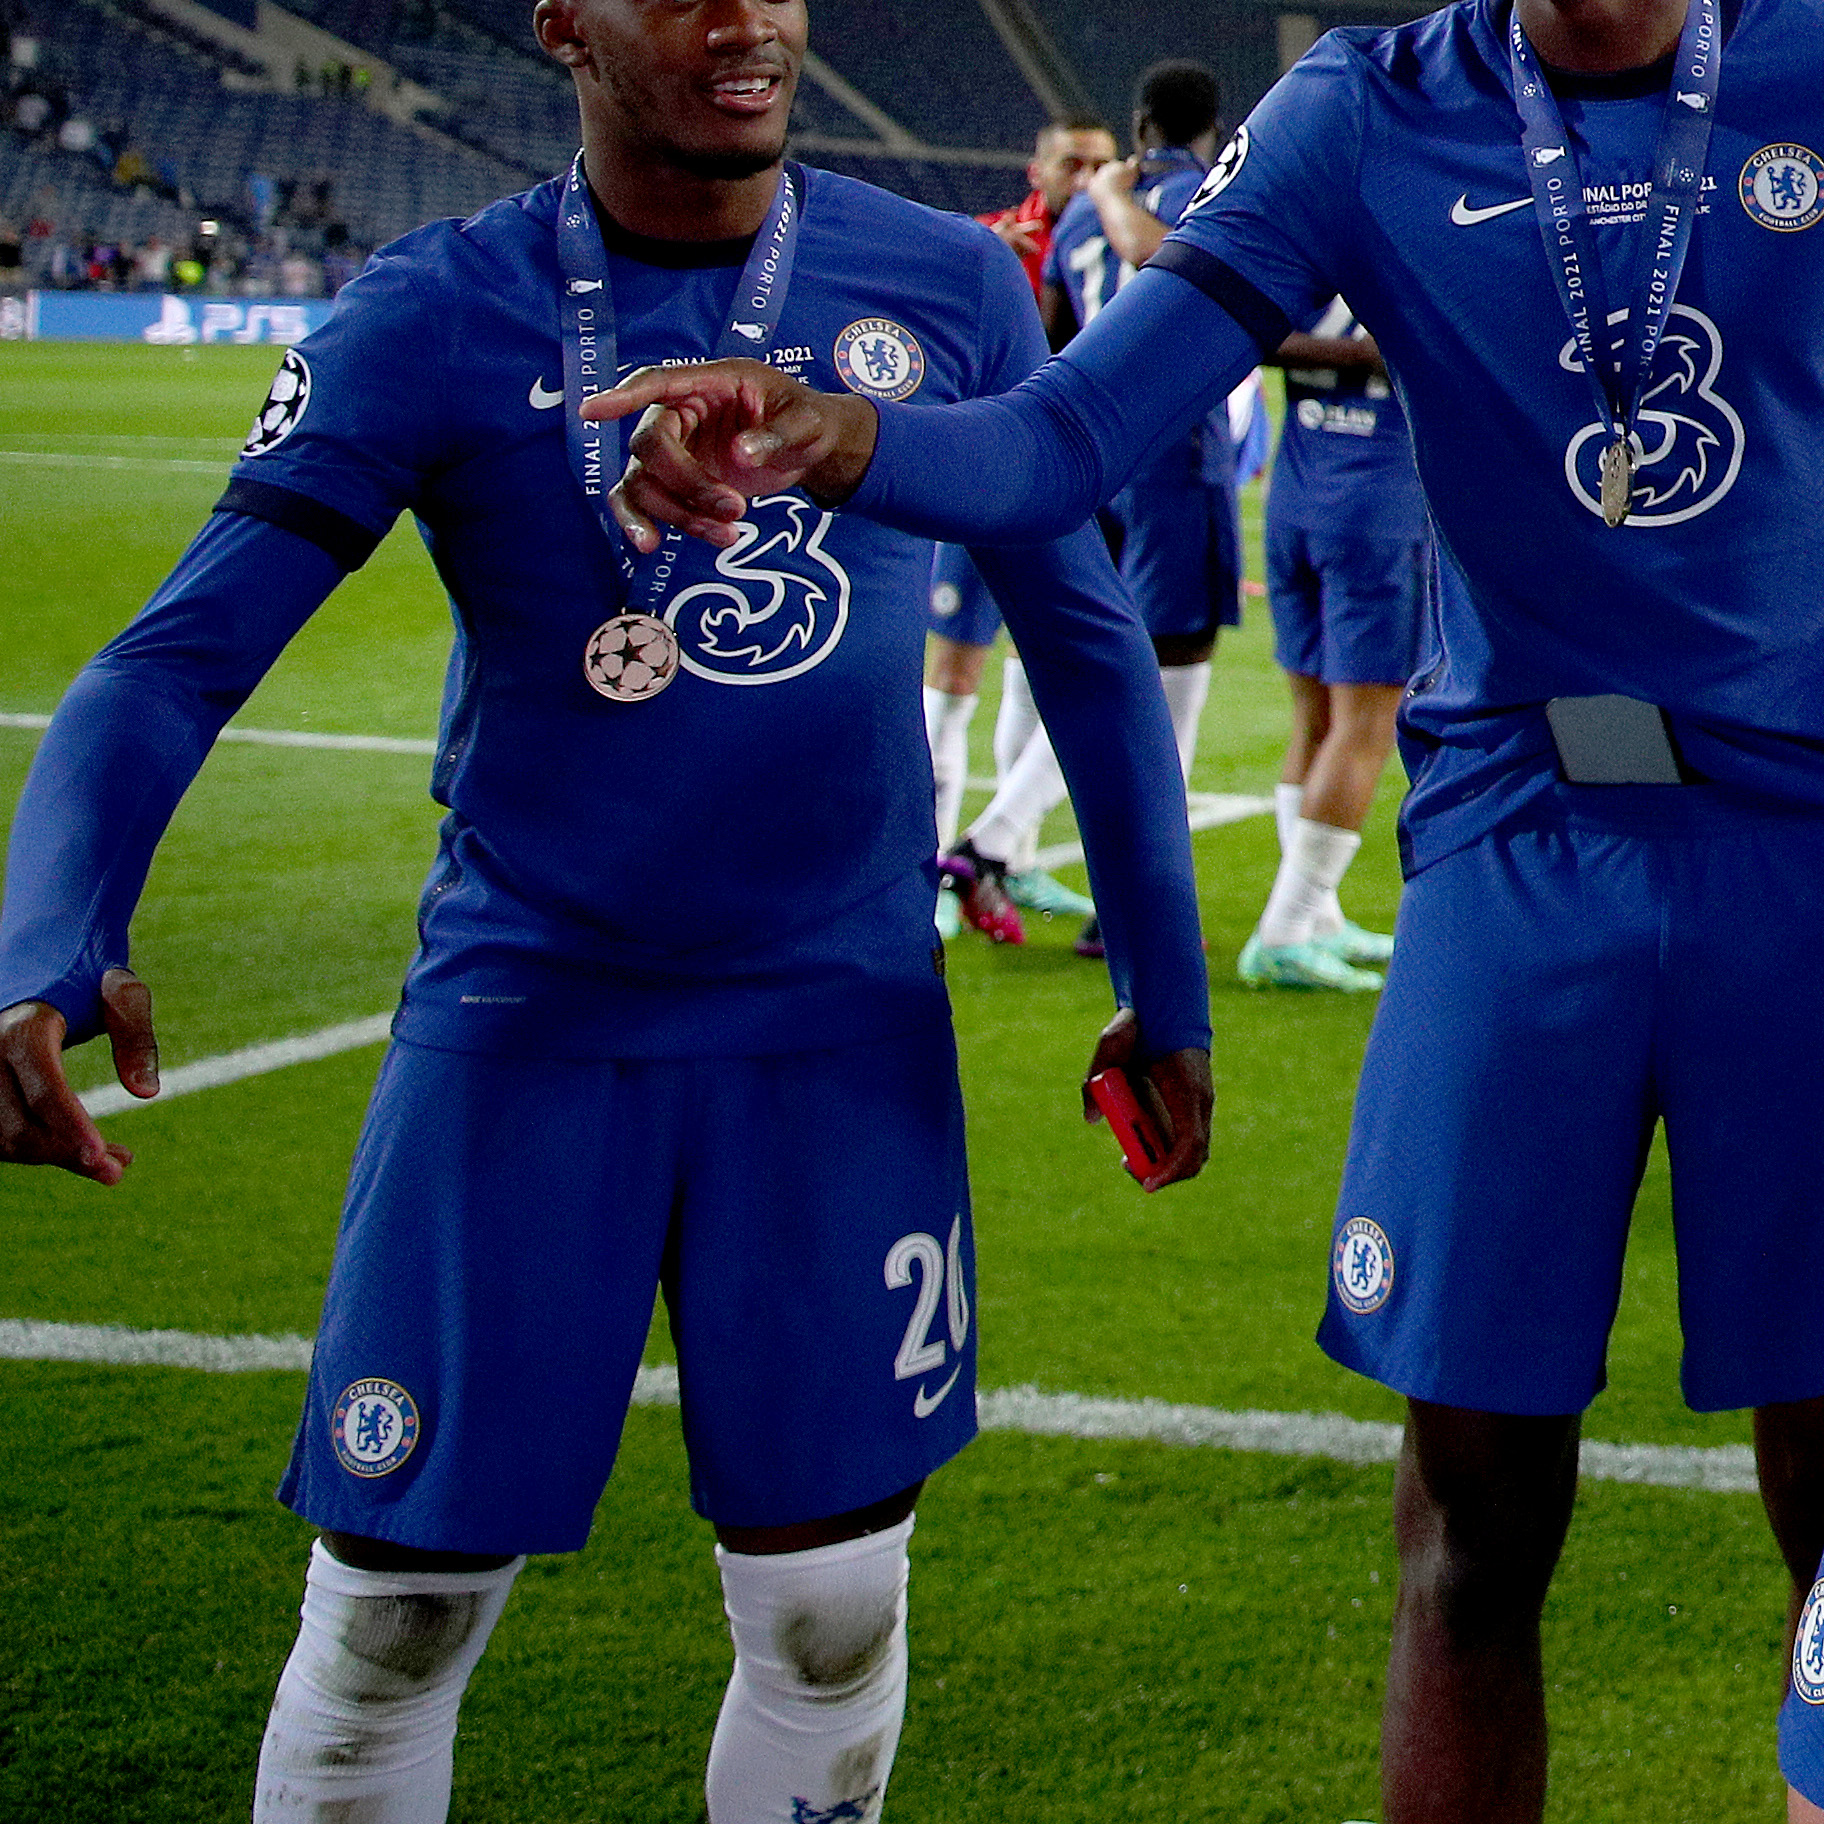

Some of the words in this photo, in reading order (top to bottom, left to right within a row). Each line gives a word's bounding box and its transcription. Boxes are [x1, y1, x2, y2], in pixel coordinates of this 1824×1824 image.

[1691, 12, 1714, 78] PORTO
[1752, 146, 1812, 168] CHELSEA
[1546, 177, 1575, 247] PORTO
[1655, 203, 1680, 261] FINAL
[751, 244, 781, 309] PORTO
[1561, 252, 1585, 301] 2021
[1646, 269, 1669, 316] 2021
[202, 301, 311, 344] PS5
[578, 307, 597, 377] PORTO
[843, 321, 901, 343] CHELSEA
[773, 346, 814, 364] 2021
[585, 439, 602, 496] FINAL
[348, 1381, 405, 1407] CHELSEA
